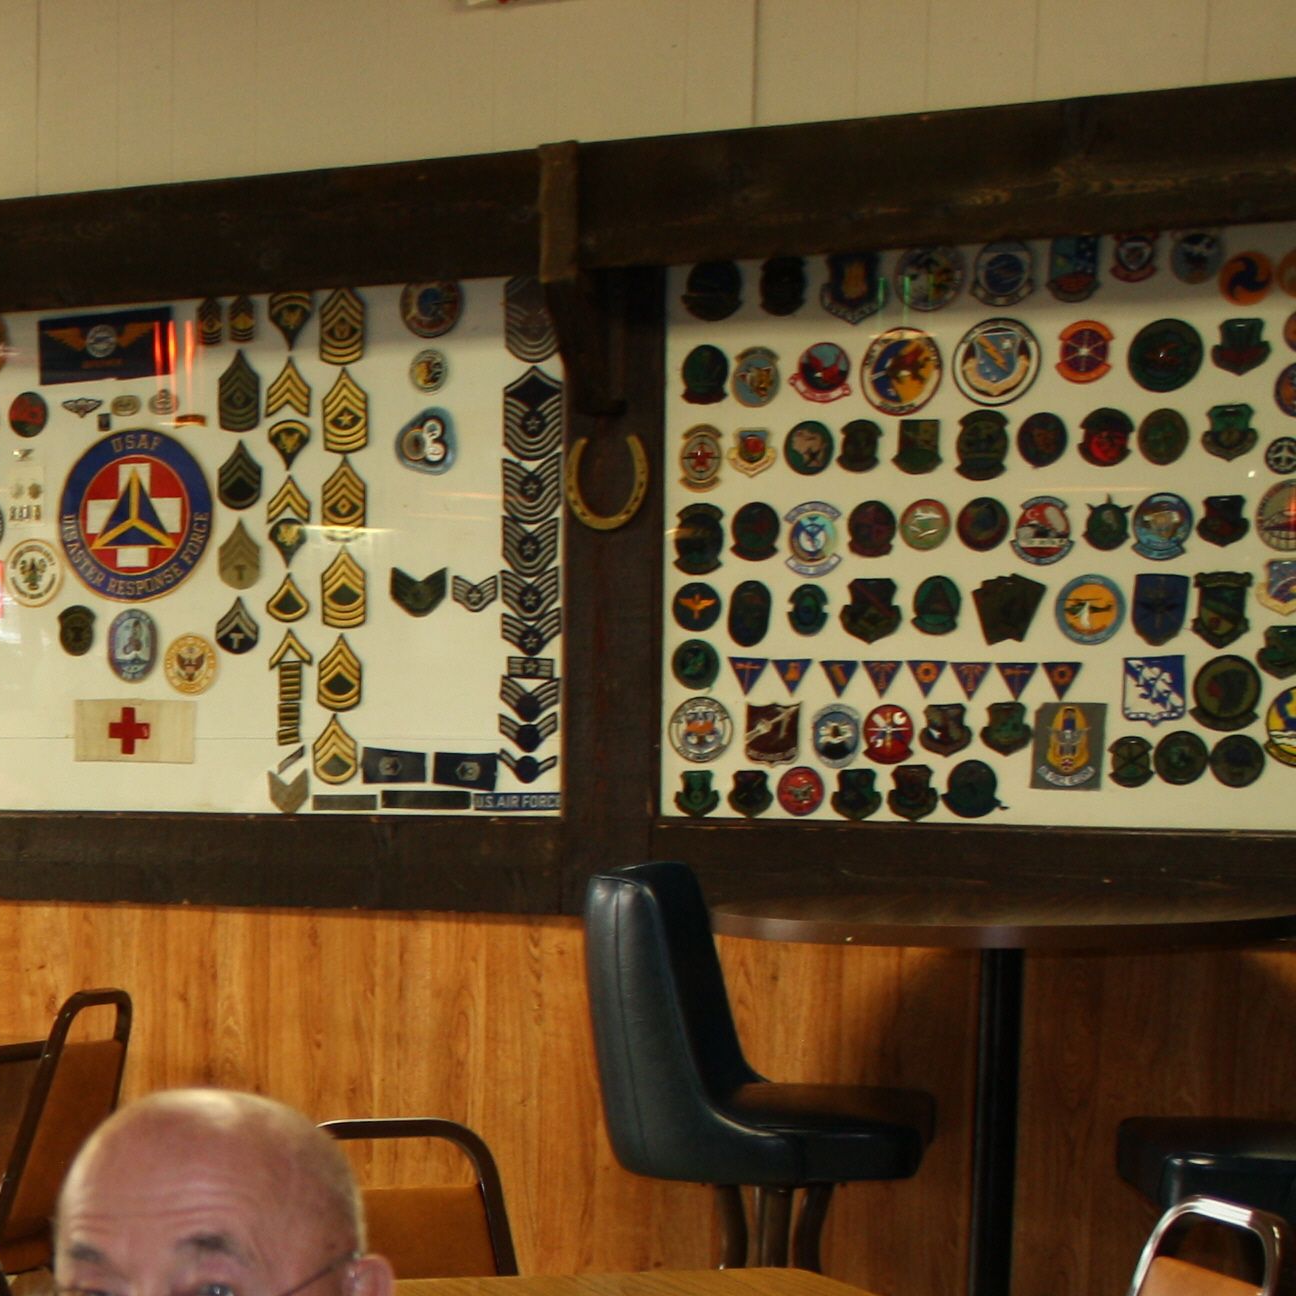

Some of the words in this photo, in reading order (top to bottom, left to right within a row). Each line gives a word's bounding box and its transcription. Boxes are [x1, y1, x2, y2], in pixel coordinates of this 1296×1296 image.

[111, 434, 162, 452] USAF
[63, 514, 106, 587] DISASTER
[107, 563, 184, 596] RESPONSE
[180, 512, 209, 566] FORCE
[497, 795, 520, 808] AIR
